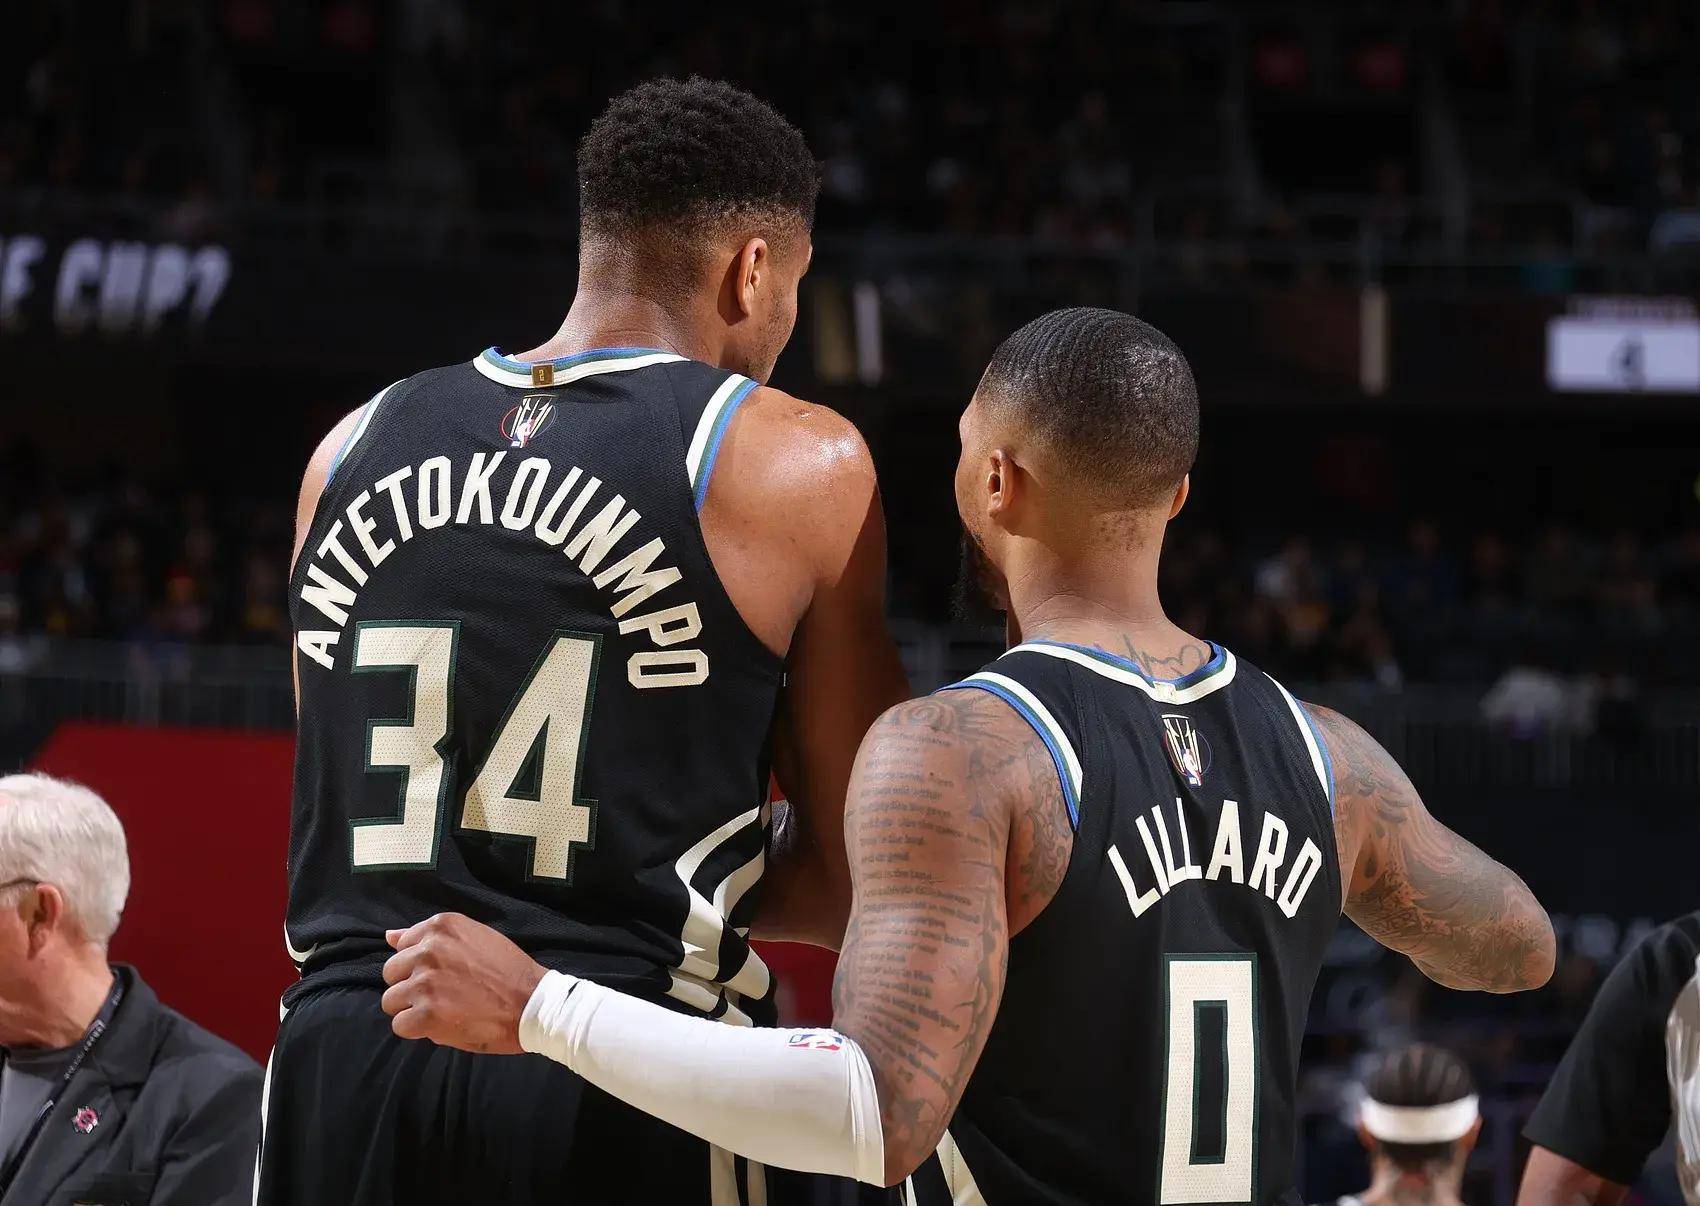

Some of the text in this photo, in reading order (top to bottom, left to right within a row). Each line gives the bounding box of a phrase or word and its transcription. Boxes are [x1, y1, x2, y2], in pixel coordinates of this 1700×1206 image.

[298, 451, 709, 690] ANTETOKOUNMPO
[351, 620, 601, 885] 34
[1107, 797, 1322, 919] LILLARD
[1162, 954, 1257, 1206] 0
